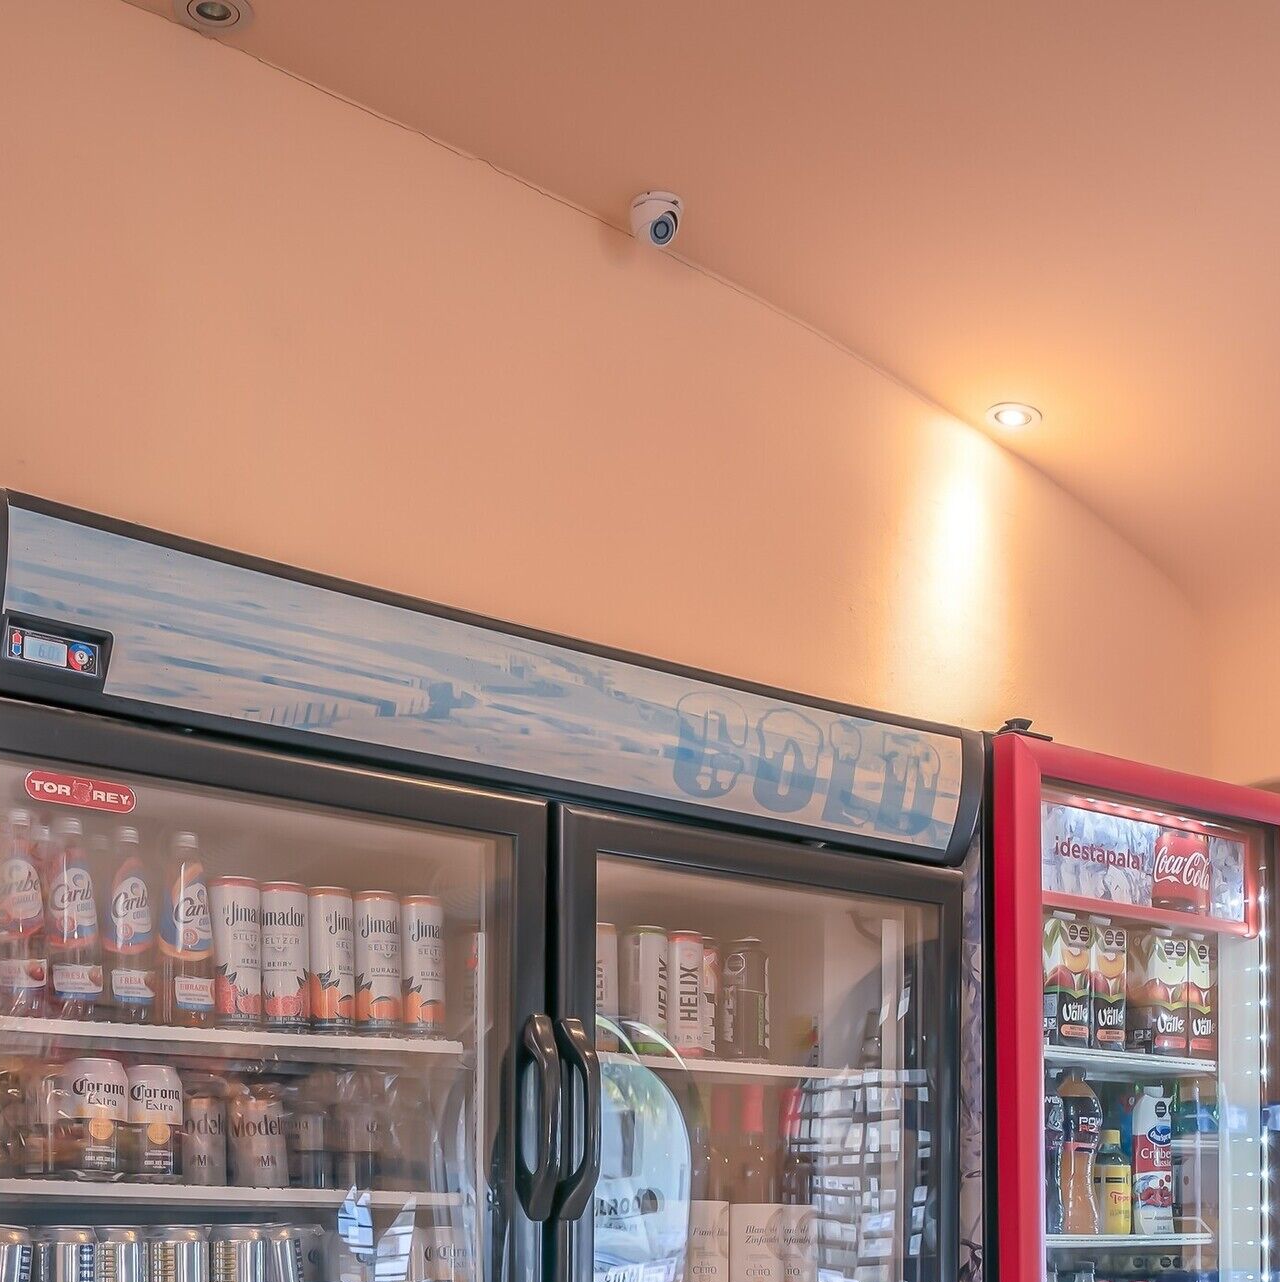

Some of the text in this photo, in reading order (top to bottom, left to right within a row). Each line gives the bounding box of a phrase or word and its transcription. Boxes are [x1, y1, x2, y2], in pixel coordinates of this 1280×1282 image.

[672, 690, 940, 838] COLD
[30, 779, 131, 805] TOR REY
[175, 897, 210, 924] Cari
[225, 901, 261, 927] Jima
[261, 906, 306, 928] imador
[361, 915, 400, 938] Jimad
[411, 919, 443, 942] Jima
[679, 965, 699, 1022] HELIX
[1062, 1003, 1089, 1022] Valle
[1098, 1008, 1124, 1027] Valle
[72, 1078, 126, 1098] Corona
[130, 1084, 181, 1102] Corona
[87, 1094, 118, 1106] Extra
[145, 1099, 174, 1111] Extra
[232, 1114, 282, 1137] Model
[1079, 1116, 1102, 1125] POW
